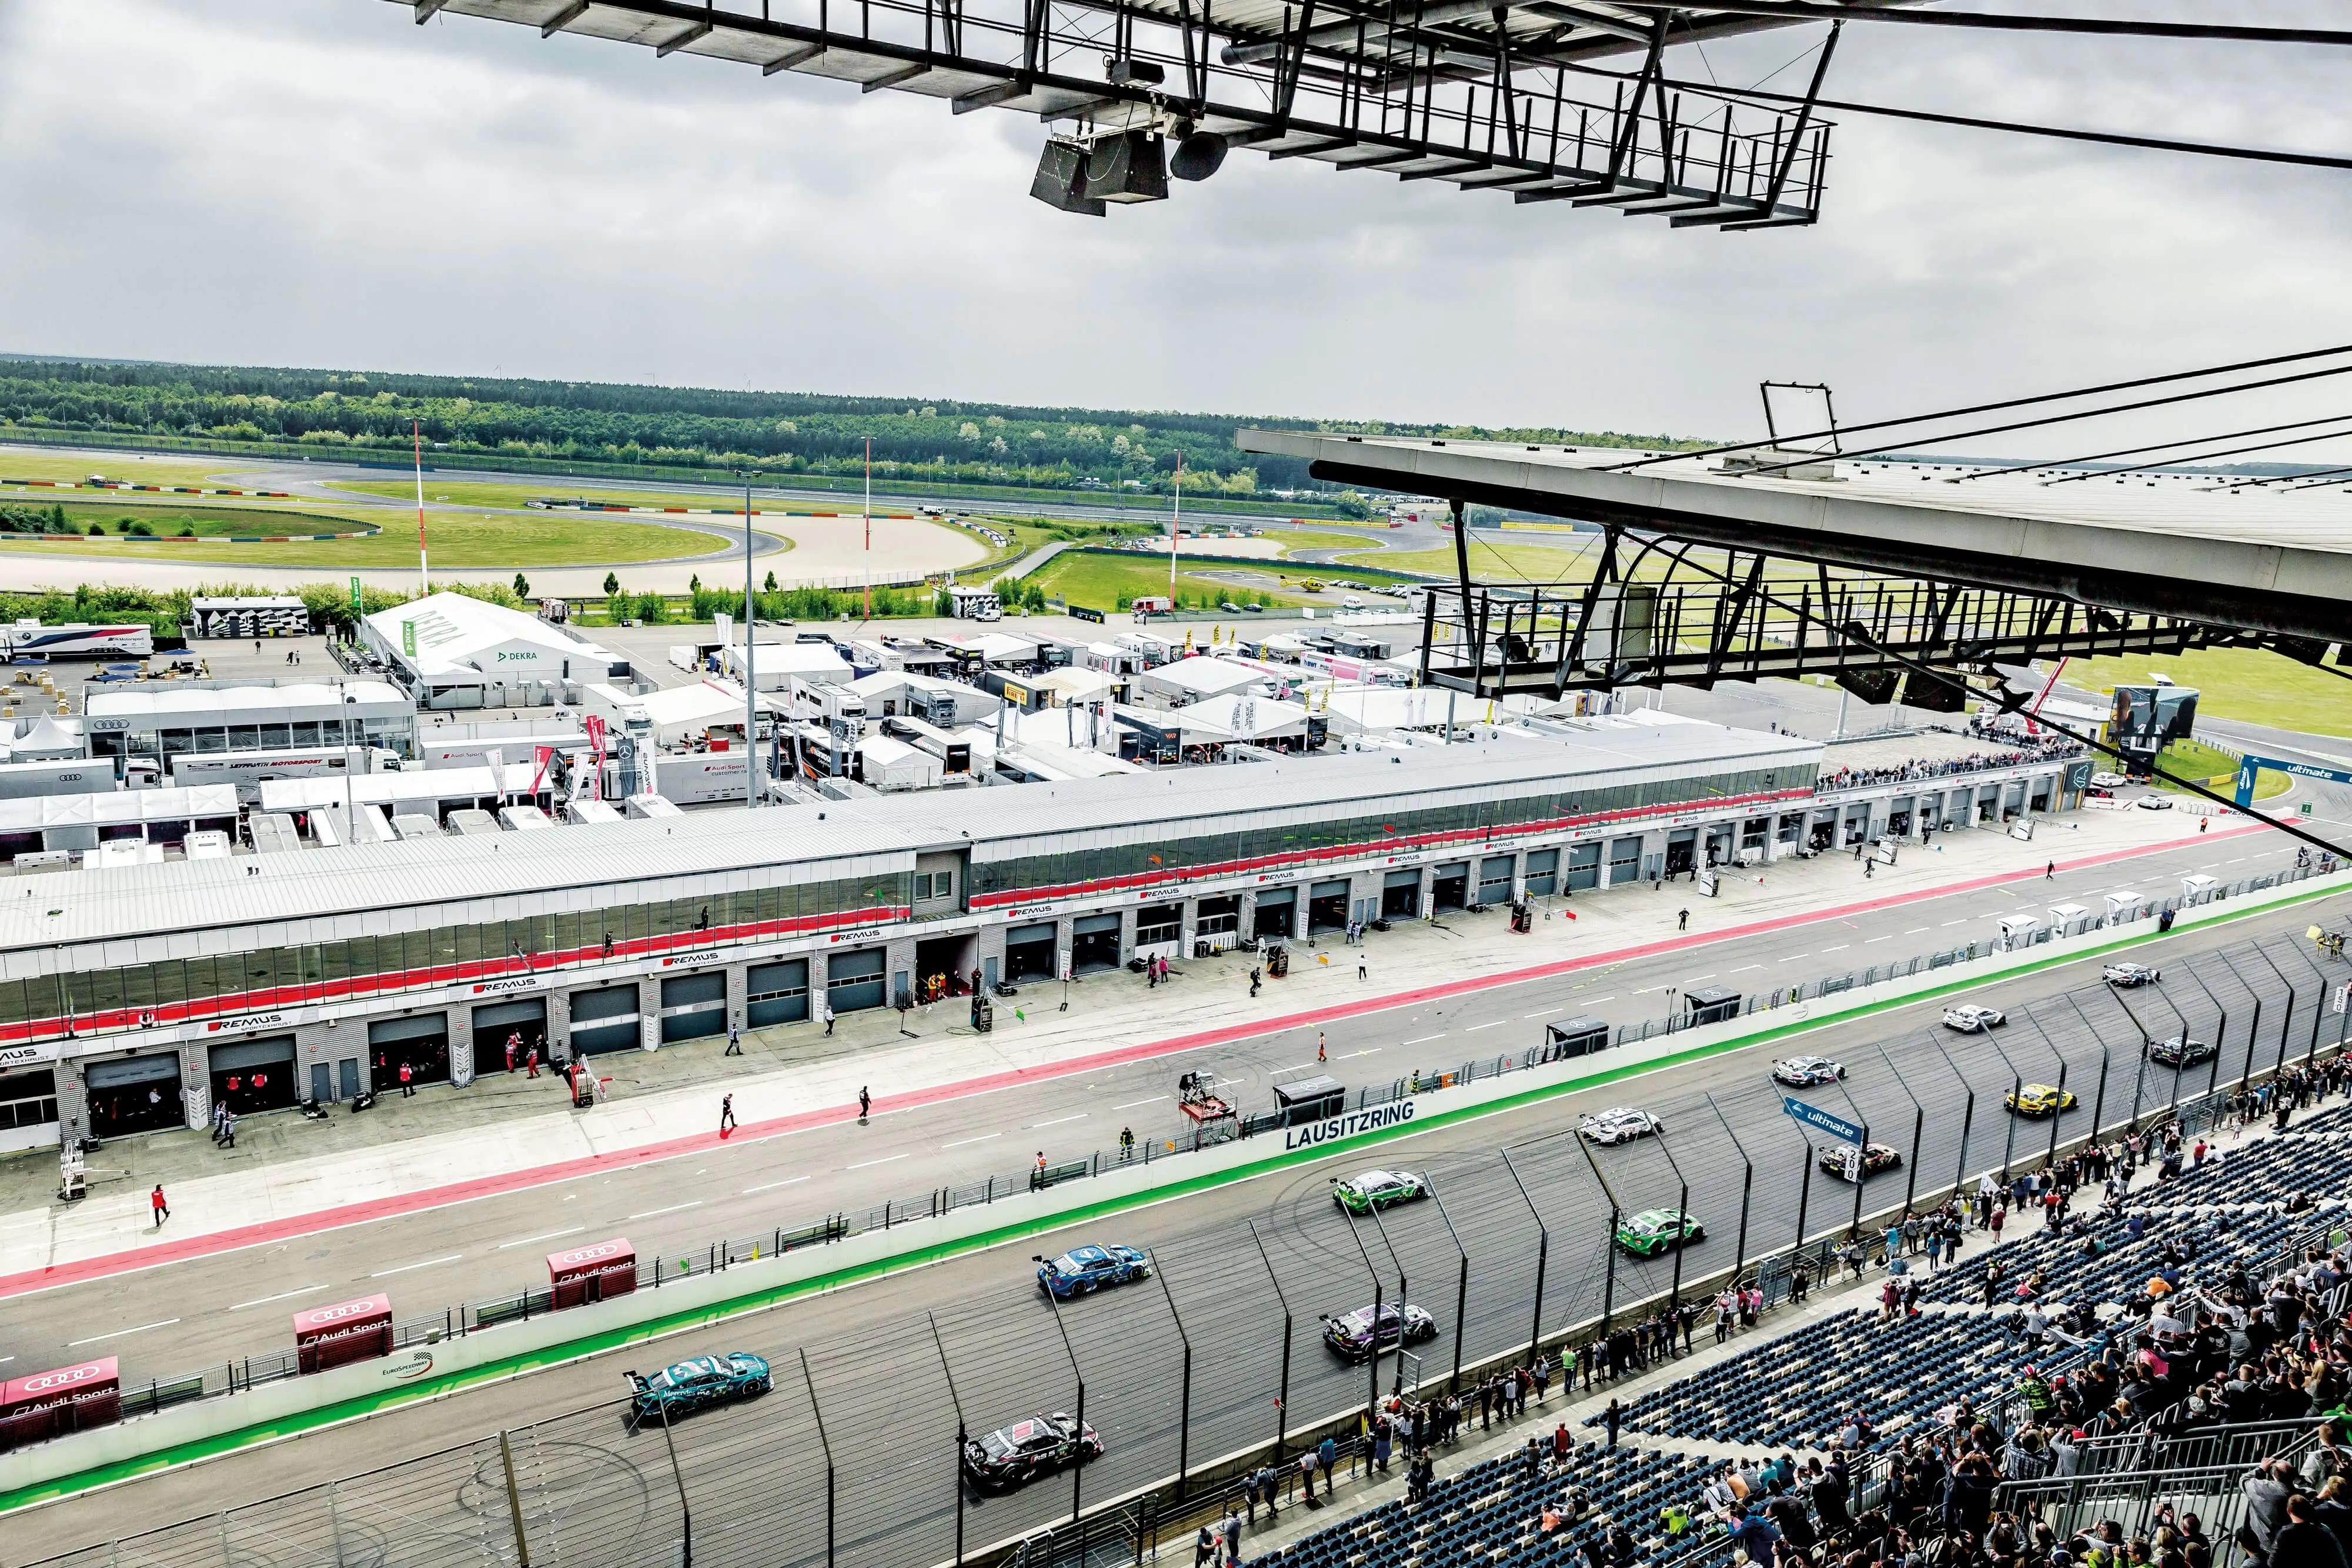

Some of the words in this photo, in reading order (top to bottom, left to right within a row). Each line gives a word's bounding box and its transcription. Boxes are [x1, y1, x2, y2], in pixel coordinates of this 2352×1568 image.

[510, 652, 537, 660] DEKRA
[1007, 686, 1025, 701] PIRELI
[2240, 767, 2248, 789] ultimate
[2287, 765, 2333, 778] ultimate
[1264, 872, 1294, 881] REMUS
[1147, 888, 1180, 898] REMUS
[1015, 906, 1052, 915] REMUS
[838, 930, 880, 941] REMUS
[671, 953, 719, 964] REMUS
[687, 958, 726, 967] SPORTEXHAUST
[484, 978, 536, 991] REMUS
[501, 984, 545, 994] SPORTEXHAUST
[220, 1015, 282, 1029] REMUS
[241, 1021, 292, 1031] SPORTEXHAUST
[1286, 1102, 1414, 1150] LAUSITZRING
[1808, 1112, 1854, 1137] ultimate
[1847, 1149, 1856, 1178] 200
[574, 1269, 599, 1281] Audi
[600, 1261, 633, 1273] Sport
[320, 1328, 349, 1341] Audi
[353, 1320, 389, 1333] Sport
[33, 1397, 68, 1412] Audi
[72, 1387, 115, 1402] Sport
[663, 1389, 696, 1397] Mercedes
